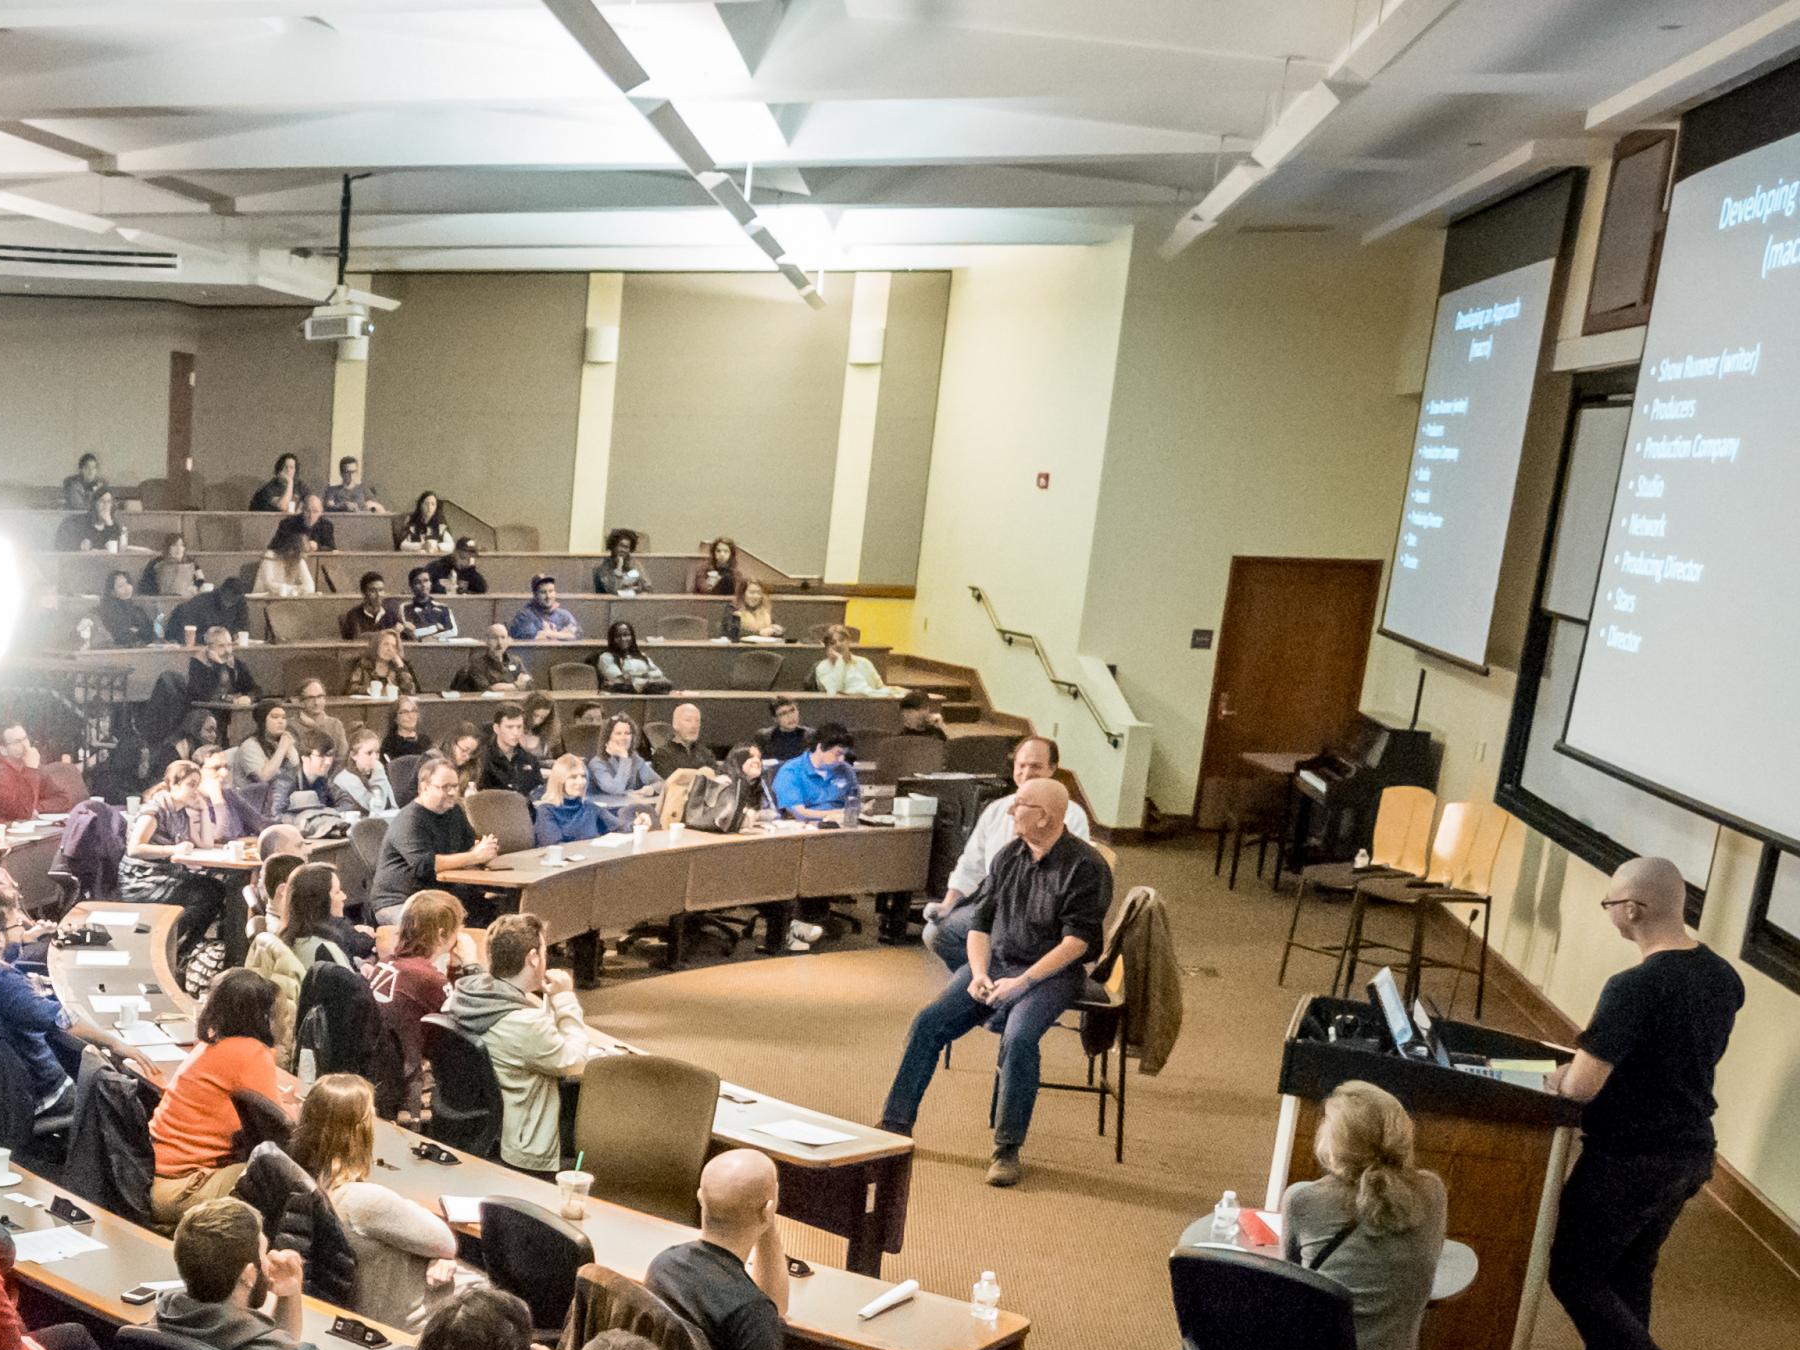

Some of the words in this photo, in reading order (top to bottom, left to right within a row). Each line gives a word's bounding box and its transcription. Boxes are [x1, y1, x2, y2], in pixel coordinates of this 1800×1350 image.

[1718, 178, 1800, 230] Developing
[1683, 354, 1720, 378] Runner
[1718, 341, 1761, 380] (writer)
[1650, 395, 1697, 421] Producers
[1643, 434, 1692, 459] Production
[1691, 432, 1741, 463] Company
[1663, 554, 1704, 582] Director
